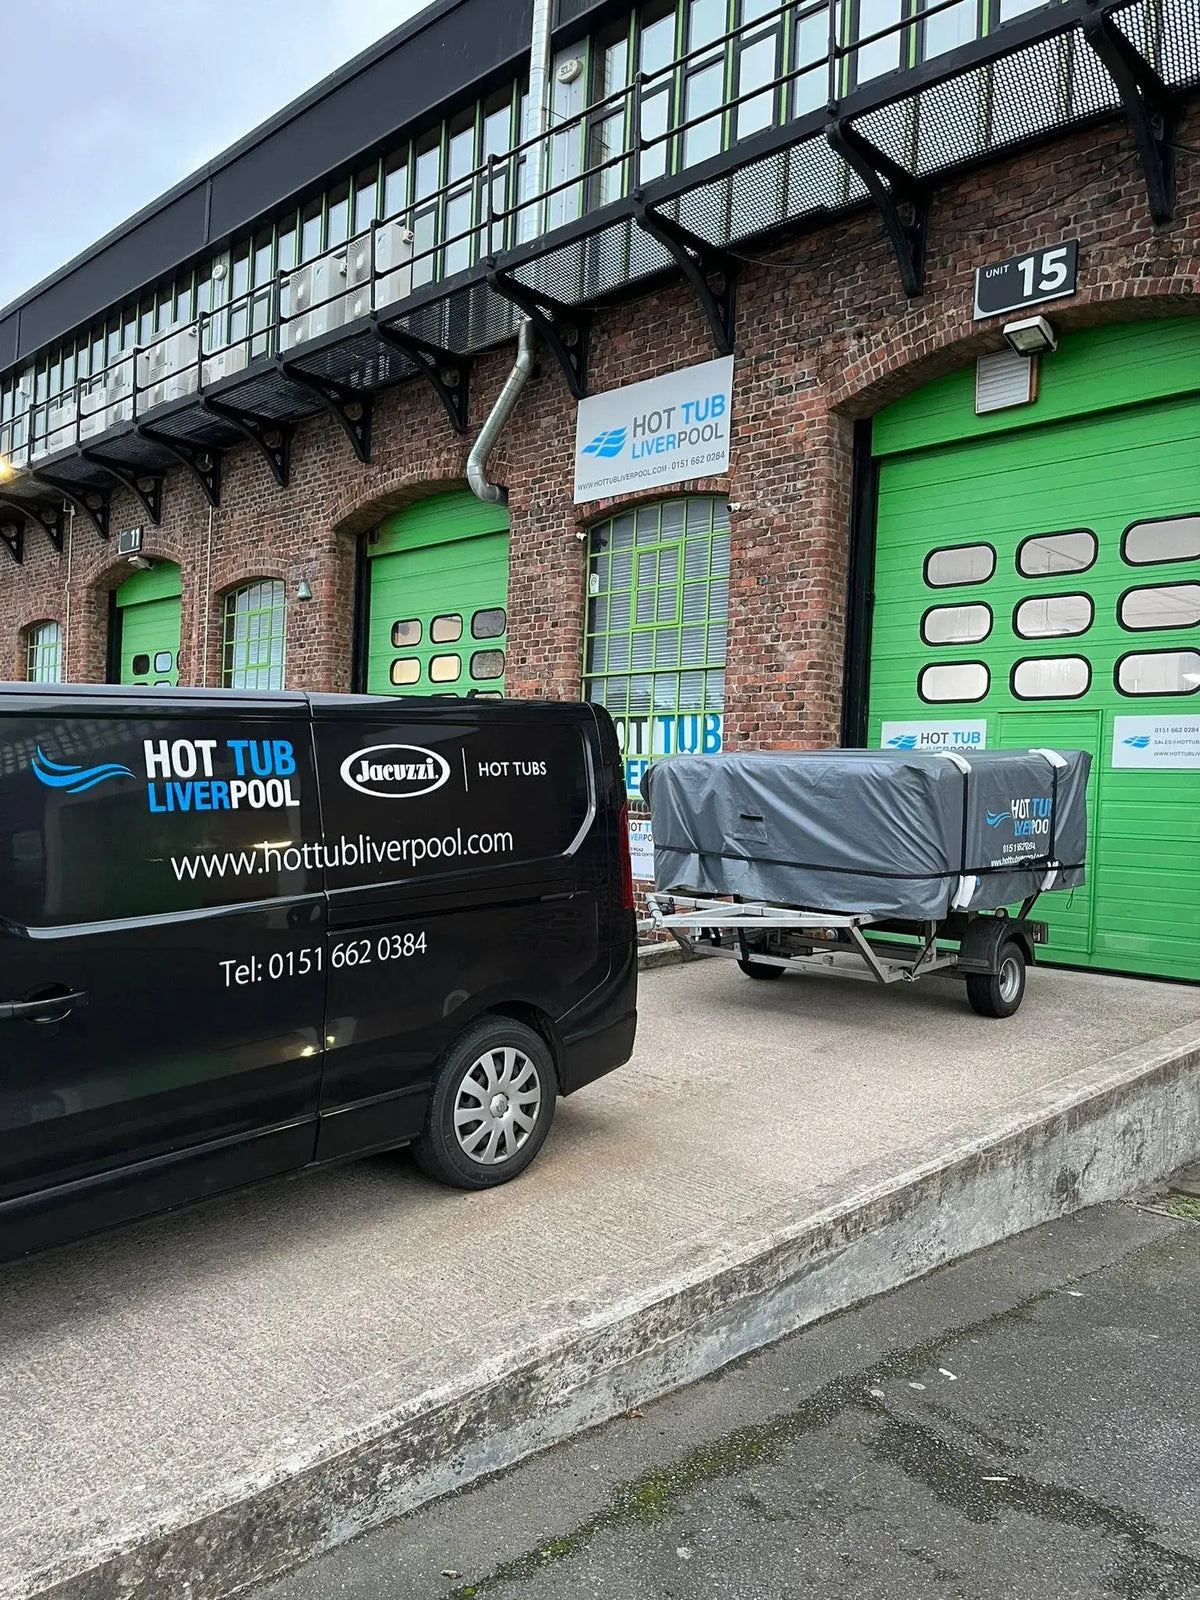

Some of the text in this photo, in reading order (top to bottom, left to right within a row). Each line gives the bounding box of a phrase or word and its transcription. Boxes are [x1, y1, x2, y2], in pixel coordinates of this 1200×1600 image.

[985, 247, 1068, 297] UNIT 15
[632, 394, 726, 438] HOT TUB
[631, 423, 724, 460] LIVERPOOL
[577, 464, 667, 491] WWW.HOTTUBLIVERPOOL.COM
[671, 459, 689, 471] 0151
[690, 454, 705, 467] 662
[706, 450, 725, 464] 0284
[131, 528, 140, 547] 11
[616, 714, 722, 754] OT TUB
[920, 731, 981, 745] HOT TUB
[143, 739, 296, 779] HOT TUB
[478, 760, 547, 777] HOT TUBS
[148, 778, 300, 813] LIVERPOOL
[1011, 798, 1031, 819] HOT
[170, 828, 514, 882] www.hottubliverpool.com
[219, 932, 427, 987] Tel: 0151 662 0384
